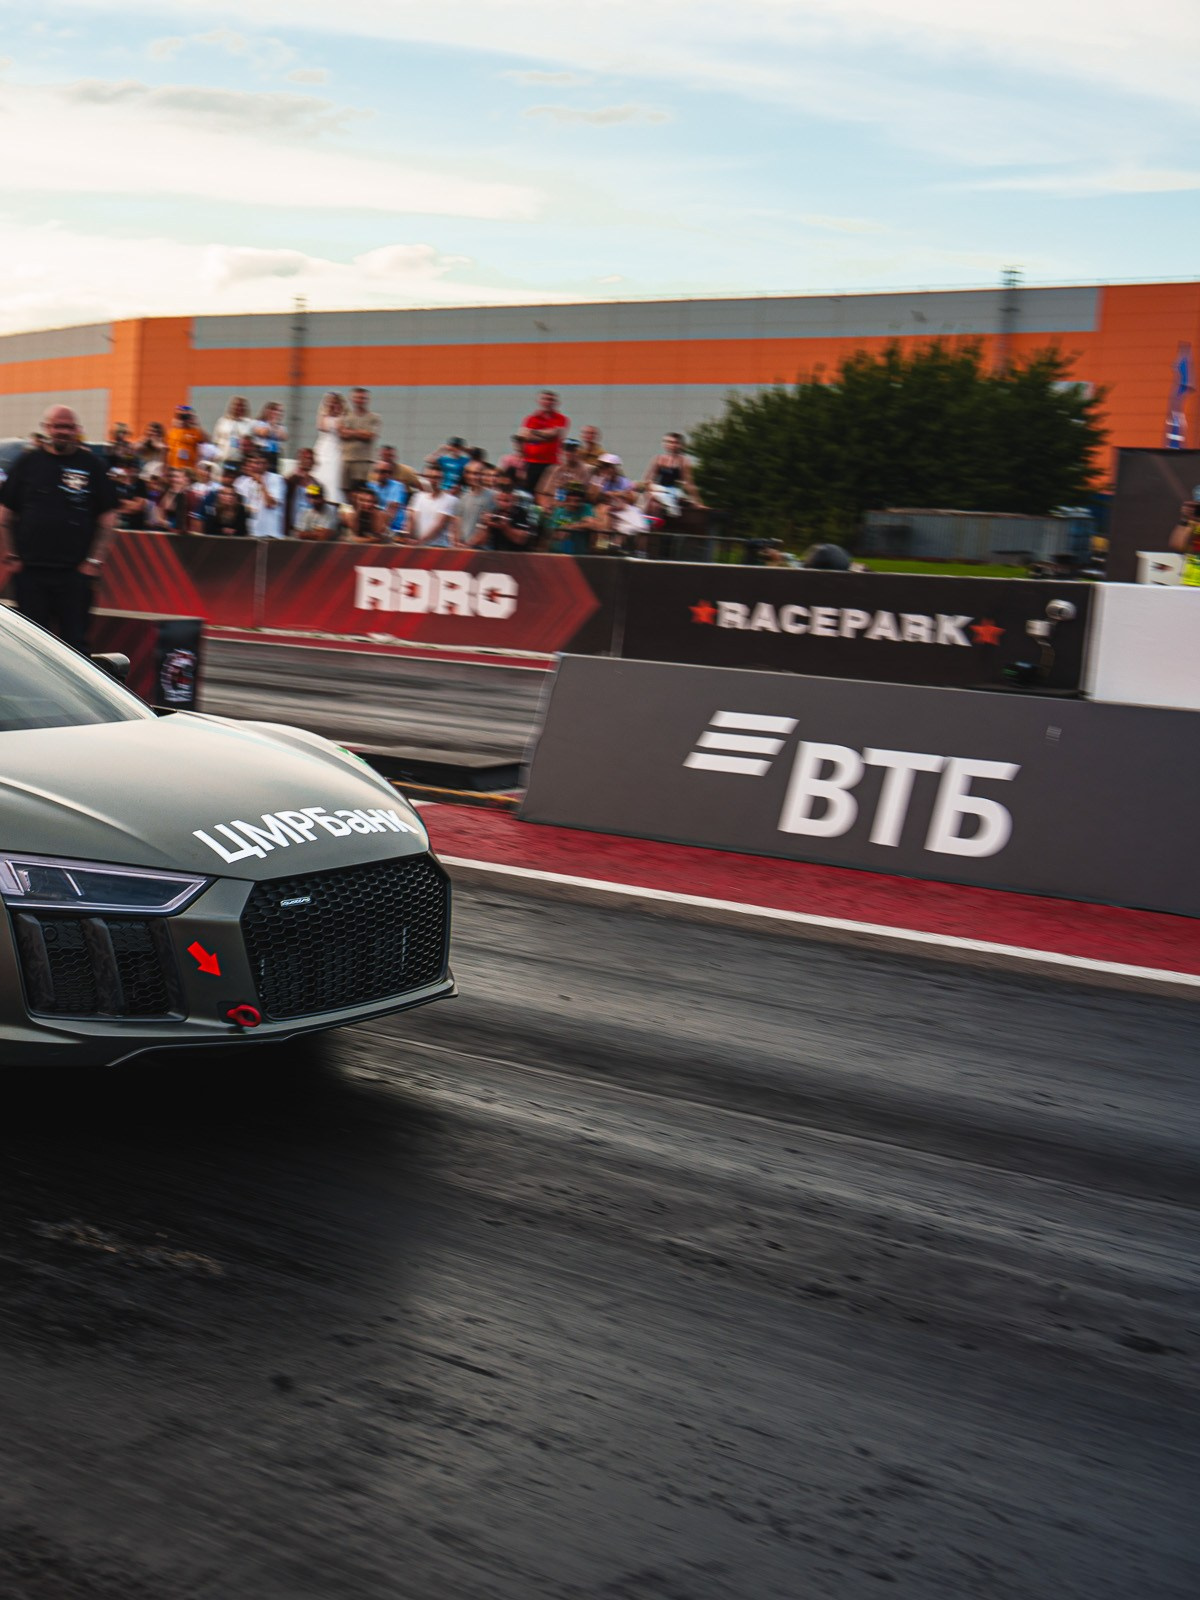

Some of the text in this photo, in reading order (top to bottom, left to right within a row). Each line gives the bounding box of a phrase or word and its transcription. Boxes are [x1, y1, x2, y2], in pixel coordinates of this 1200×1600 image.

[716, 601, 974, 647] RACEPARK
[777, 741, 1021, 857] ВТБ
[192, 806, 419, 864] ЦМРБанк
